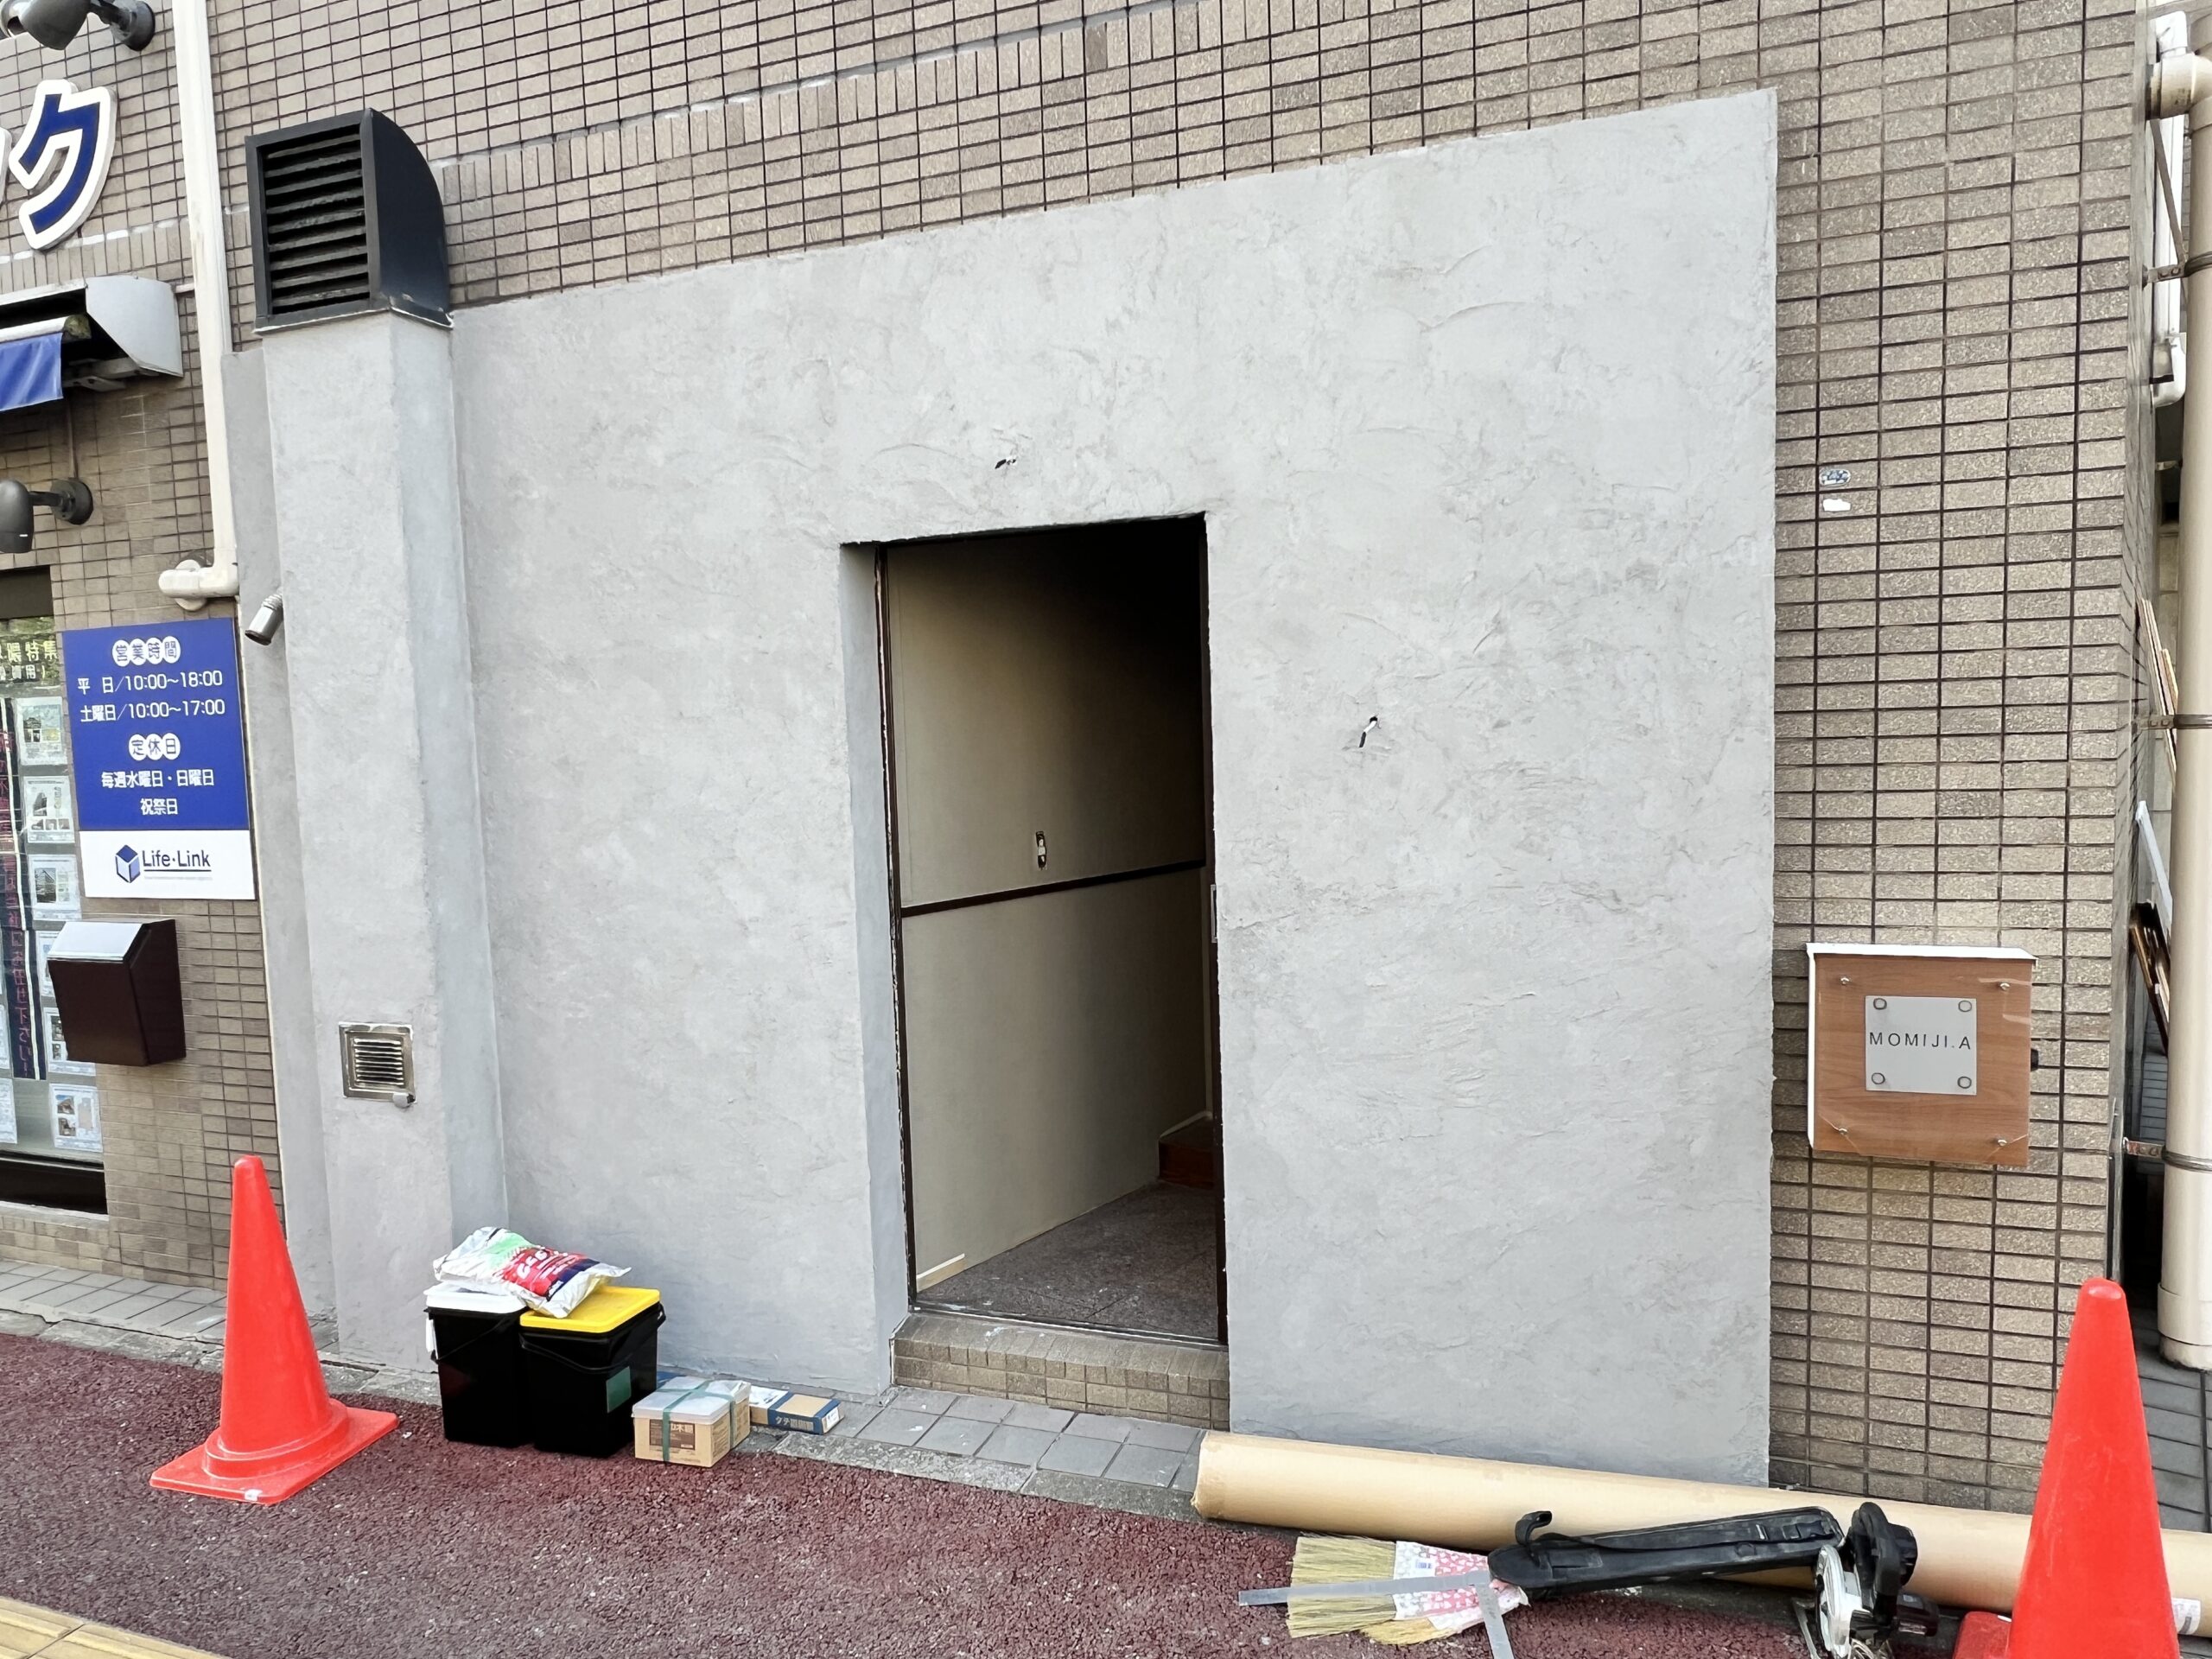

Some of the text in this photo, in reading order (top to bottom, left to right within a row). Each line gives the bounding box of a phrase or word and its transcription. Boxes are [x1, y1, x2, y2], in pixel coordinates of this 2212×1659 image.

[0, 79, 115, 249] ク
[115, 640, 177, 663] 営業時間
[130, 738, 177, 756] 定休日
[140, 798, 179, 816] 祝祭日
[1869, 1032, 1971, 1050] MOMIJI.A
